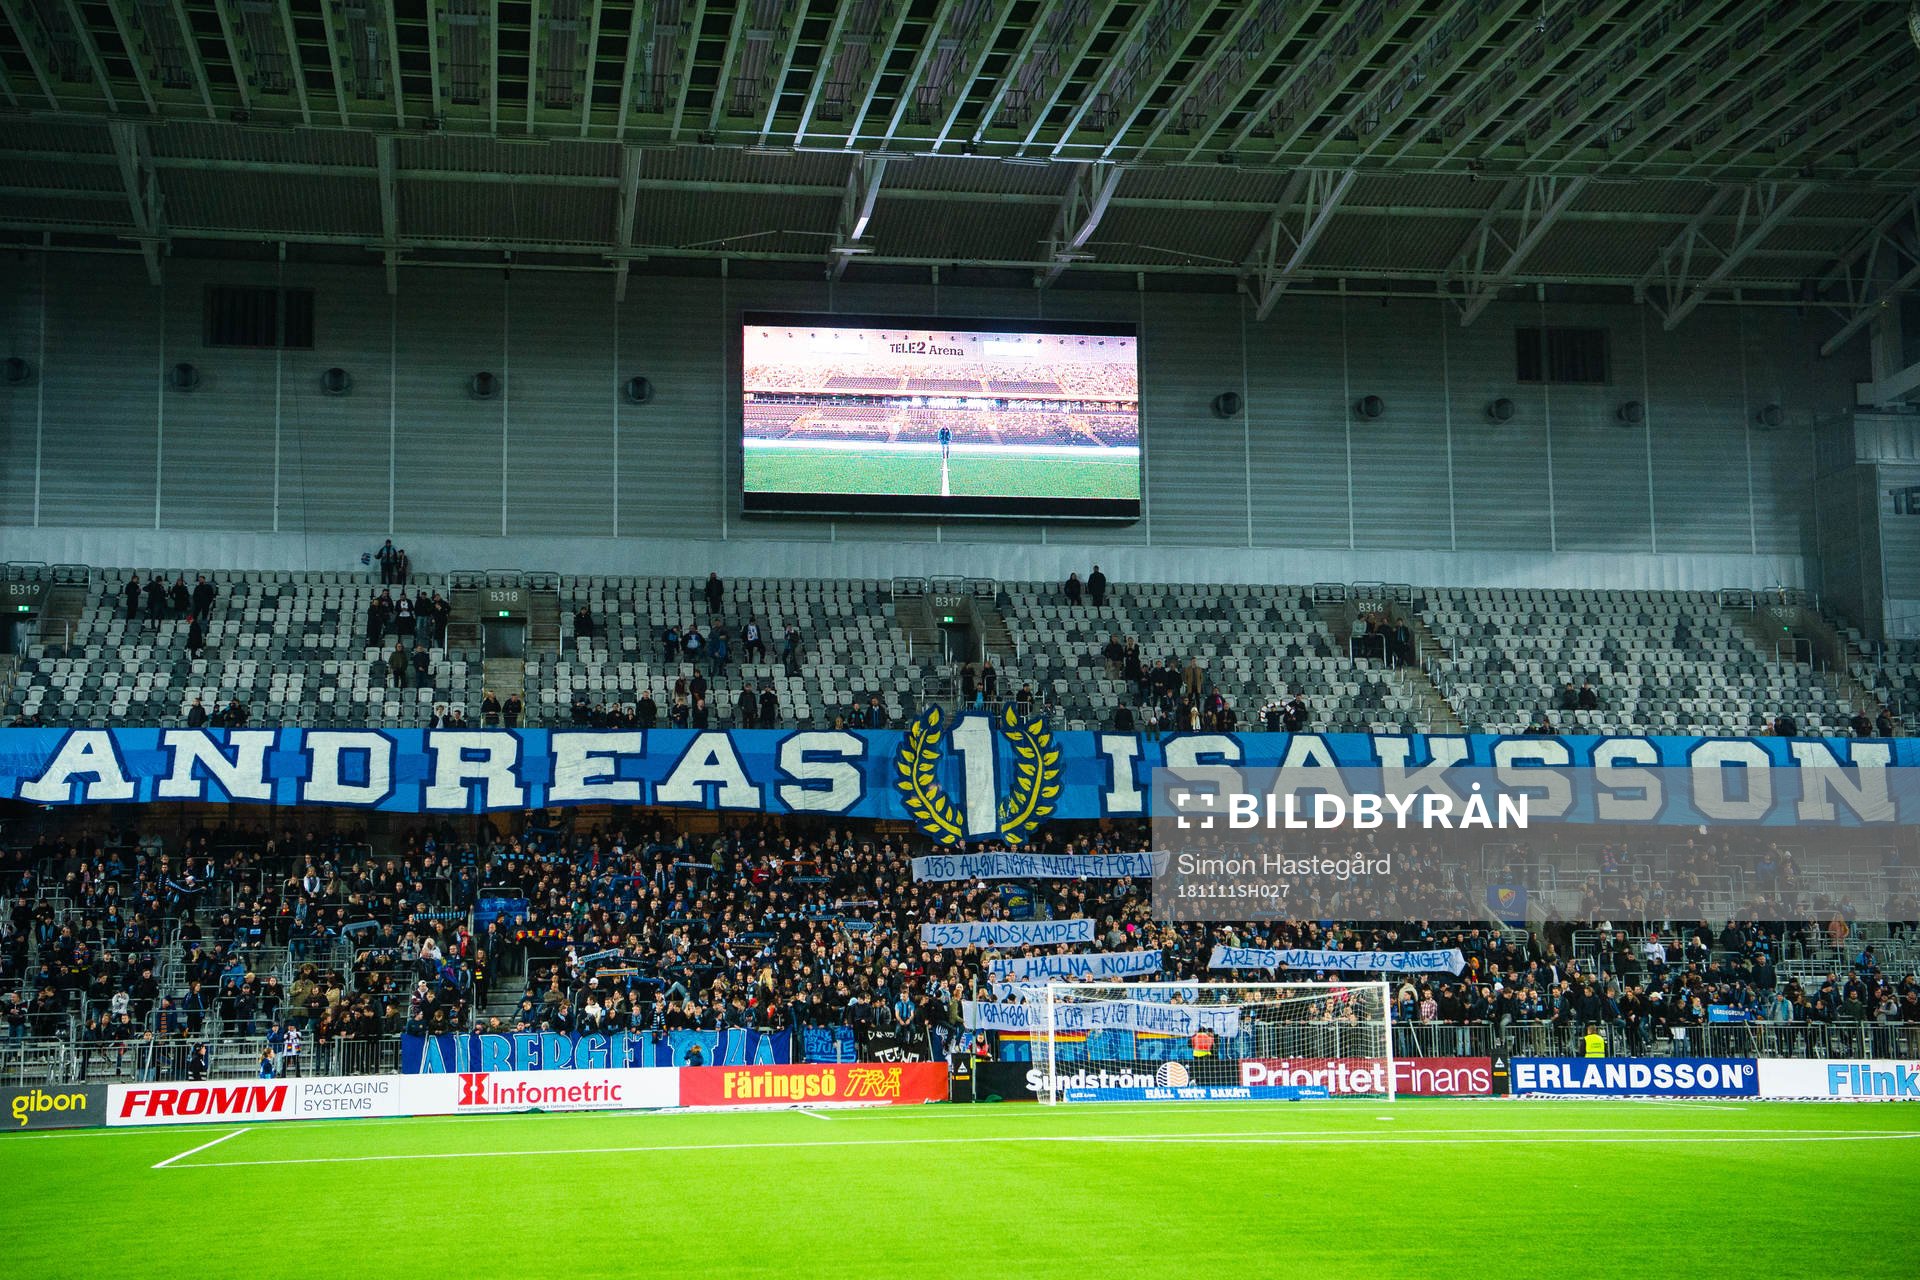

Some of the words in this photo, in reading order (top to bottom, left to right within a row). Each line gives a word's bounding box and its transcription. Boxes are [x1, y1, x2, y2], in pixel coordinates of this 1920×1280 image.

[890, 341, 926, 354] TELE2
[929, 345, 964, 356] Arena
[10, 584, 40, 595] B319
[490, 591, 518, 601] B318
[935, 596, 961, 607] B317
[1359, 602, 1384, 612] B316
[19, 729, 864, 811] ANDREAS
[951, 715, 997, 836] 1
[1101, 734, 1897, 823] ISAKSSON
[924, 857, 955, 878] 135
[960, 855, 1036, 876] ALLSVENSKA
[1042, 856, 1104, 877] MATCHER
[929, 925, 964, 945] 133
[994, 960, 1013, 977] 41
[1027, 957, 1093, 978] HÅLLNA
[1102, 951, 1163, 974] NOLLOR
[1221, 946, 1276, 967] ÅRETS
[1285, 950, 1362, 969] MÅLVAKT
[1369, 952, 1387, 968] 10
[1391, 951, 1453, 970] GÅNGER
[724, 1069, 837, 1100] Färingsö
[1026, 1069, 1154, 1091] Sundström
[1241, 1061, 1385, 1092] Prioritet
[1393, 1061, 1490, 1092] Finans
[1828, 1064, 1920, 1096] Flink
[305, 1082, 389, 1096] PACKAGING
[493, 1080, 622, 1104] Infometric
[12, 1090, 86, 1126] gibon
[120, 1085, 289, 1118] FROMM
[304, 1098, 372, 1111] SYSTEMS
